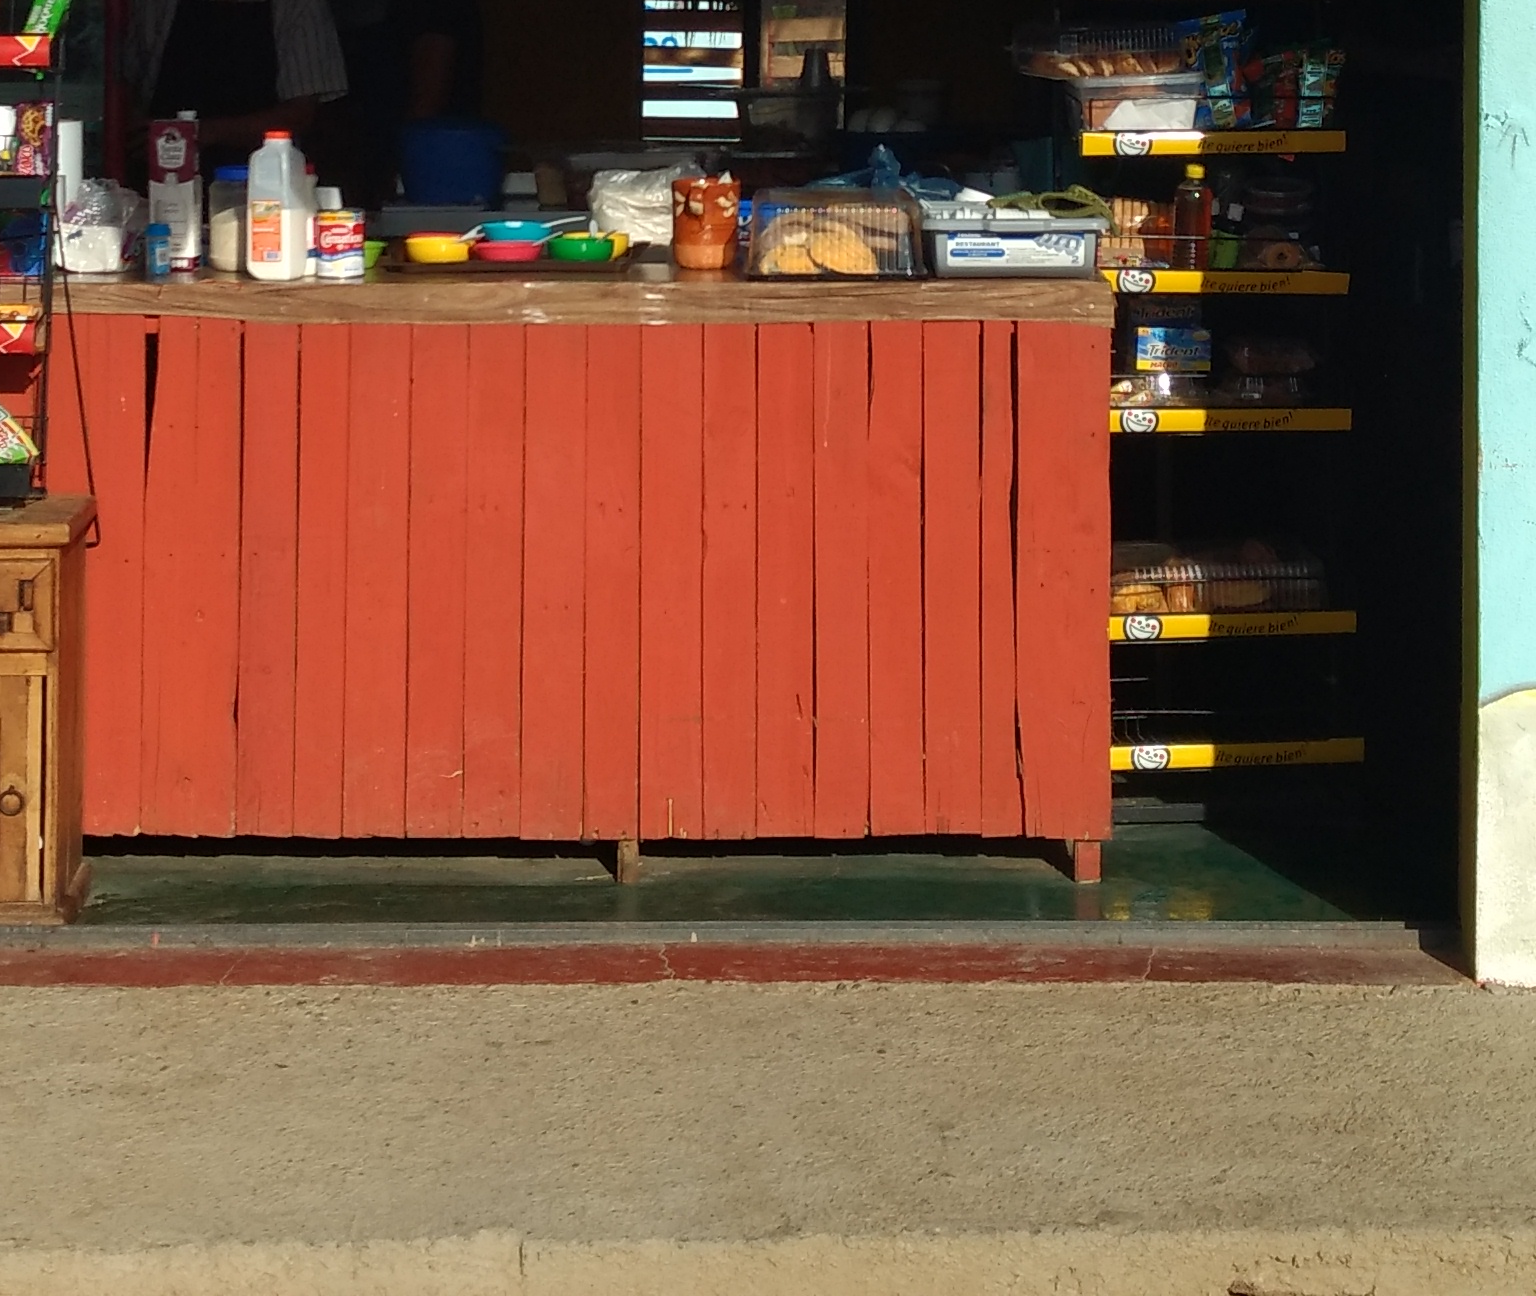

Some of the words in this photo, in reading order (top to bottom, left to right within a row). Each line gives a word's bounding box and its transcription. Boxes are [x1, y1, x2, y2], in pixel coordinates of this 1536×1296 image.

[1216, 142, 1255, 153] quiere
[1219, 281, 1257, 293] quiere
[1149, 344, 1200, 356] Trident
[1222, 419, 1260, 431] quiere
[1226, 623, 1265, 635] quiere
